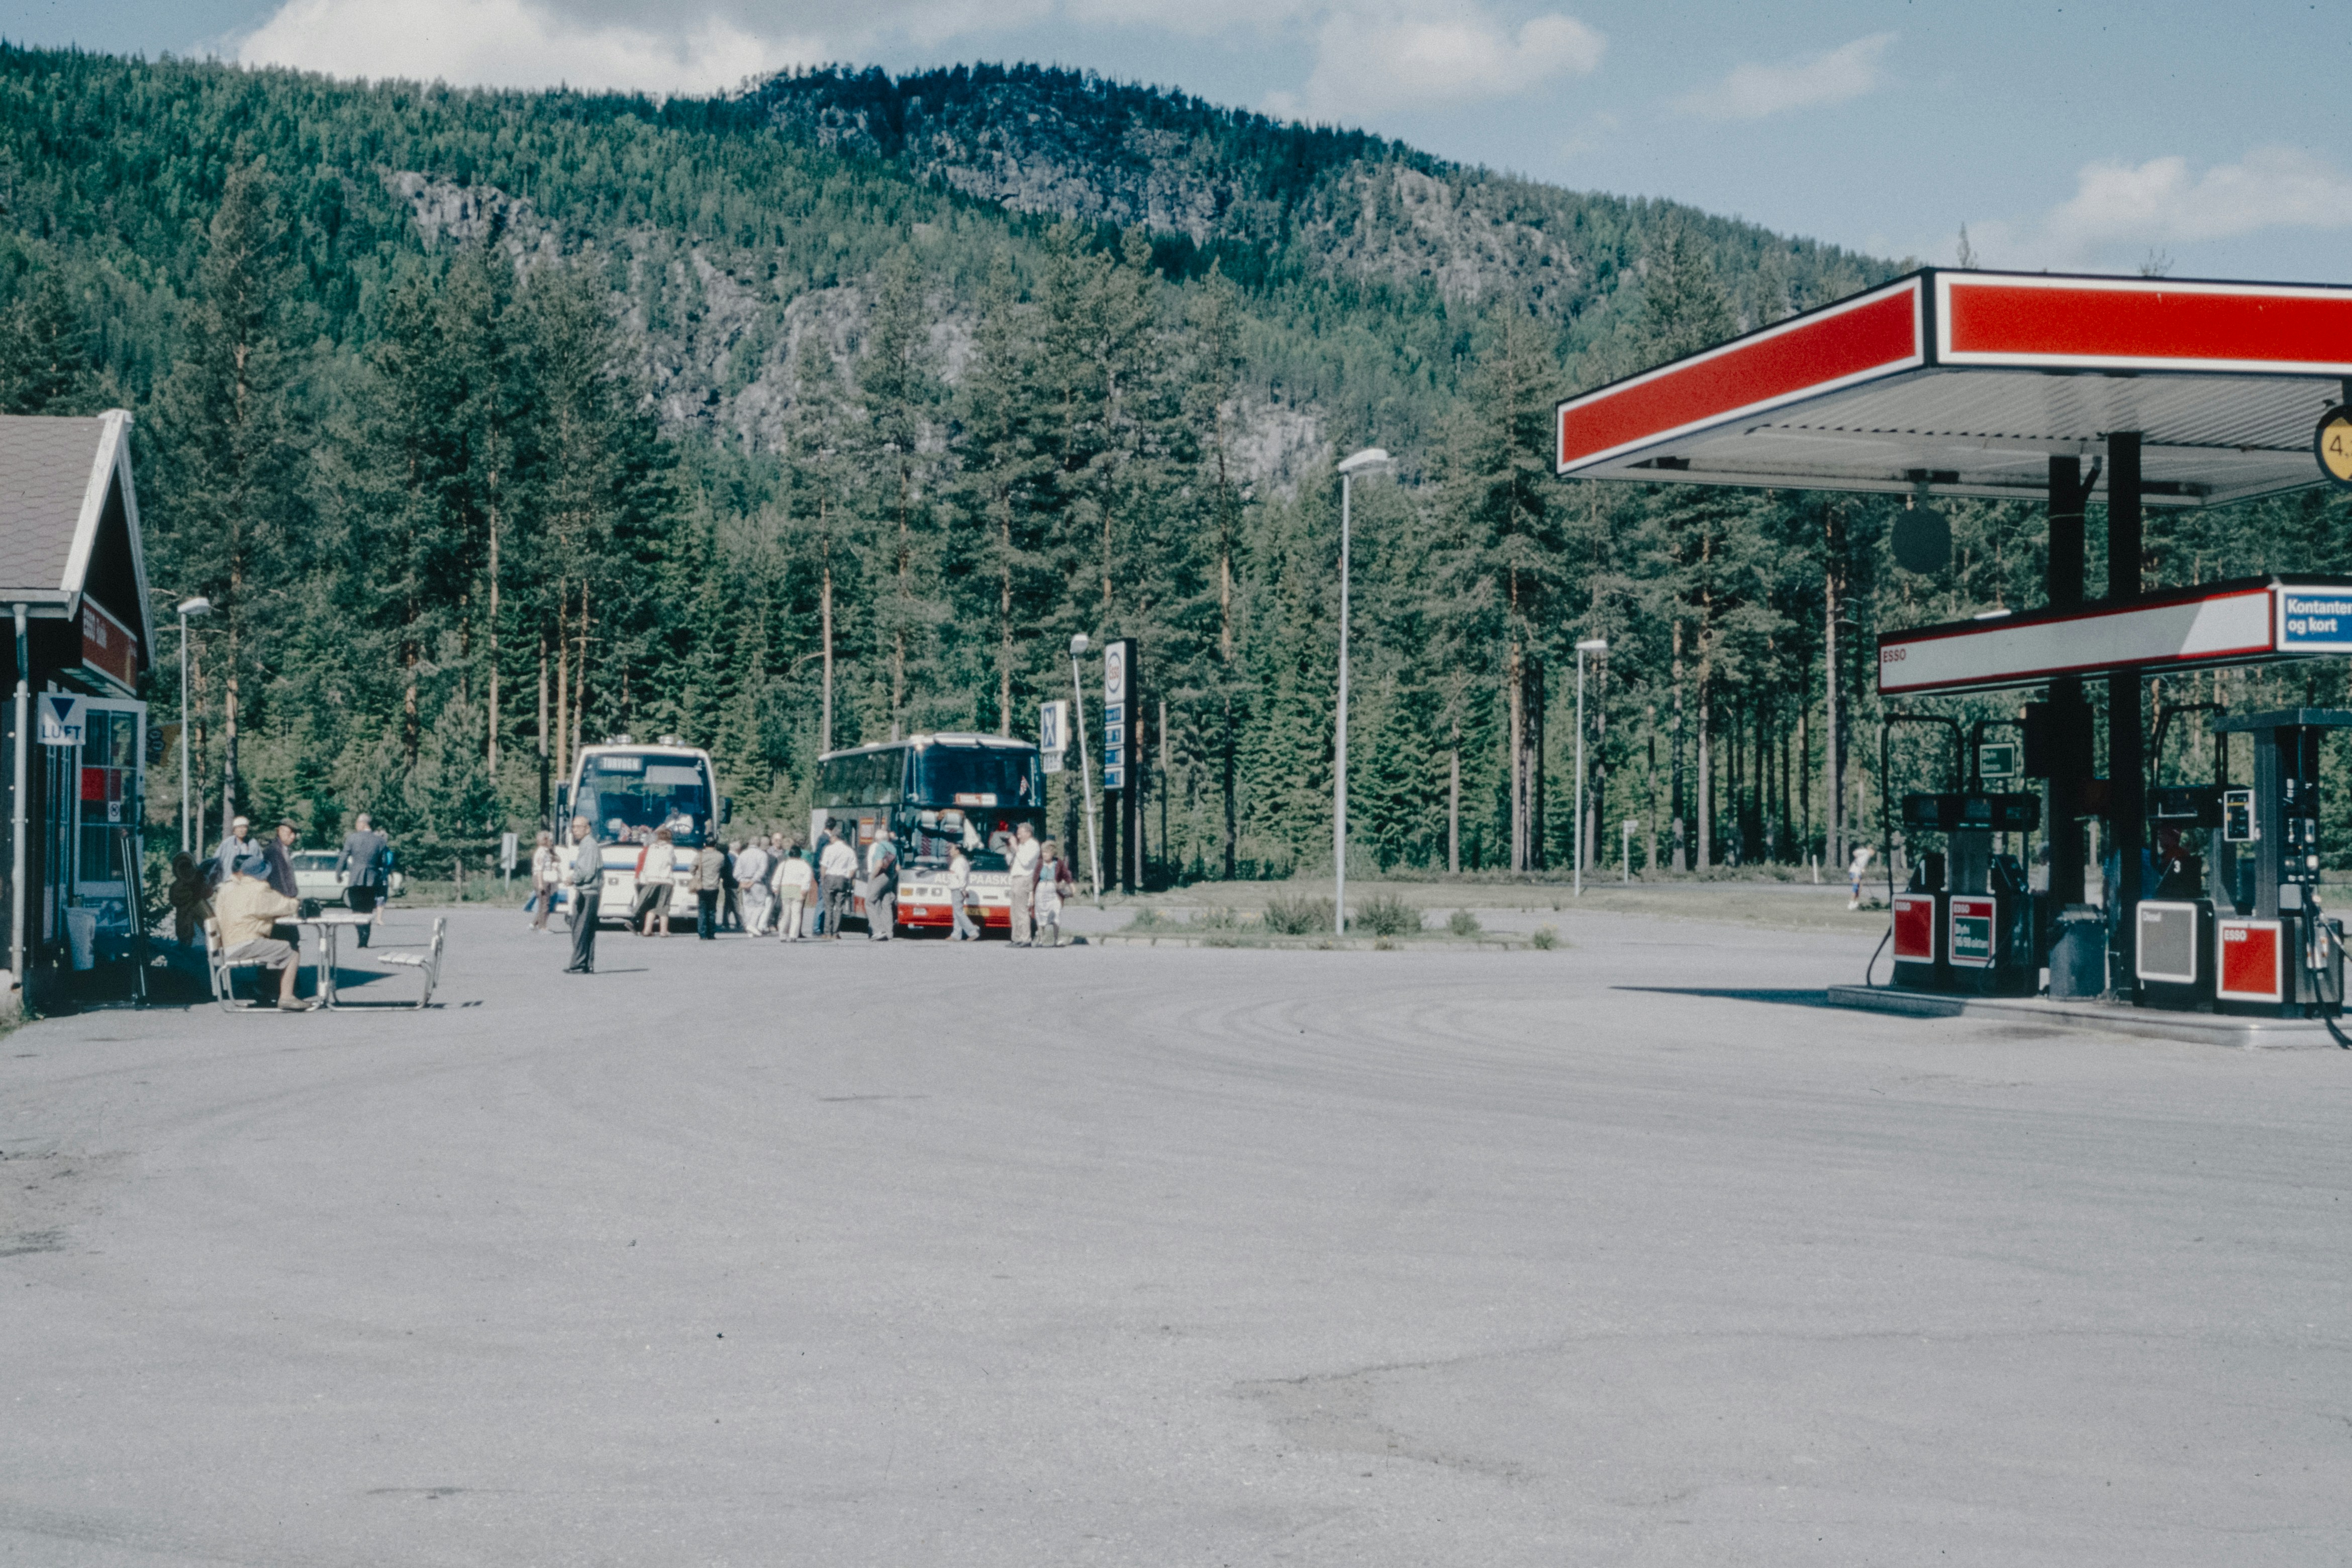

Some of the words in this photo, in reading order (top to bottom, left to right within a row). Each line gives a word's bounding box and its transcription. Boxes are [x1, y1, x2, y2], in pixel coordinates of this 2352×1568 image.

[2329, 434, 2352, 458] 4,
[2288, 599, 2352, 615] Kontanter
[2288, 619, 2306, 635] og
[2309, 616, 2338, 633] kort
[1883, 649, 1906, 662] ESSO
[42, 725, 81, 739] LUFT
[1919, 859, 1925, 885] 1
[2174, 860, 2181, 872] 3
[1953, 904, 1970, 913] ESSO
[2224, 930, 2247, 941] ESSO
